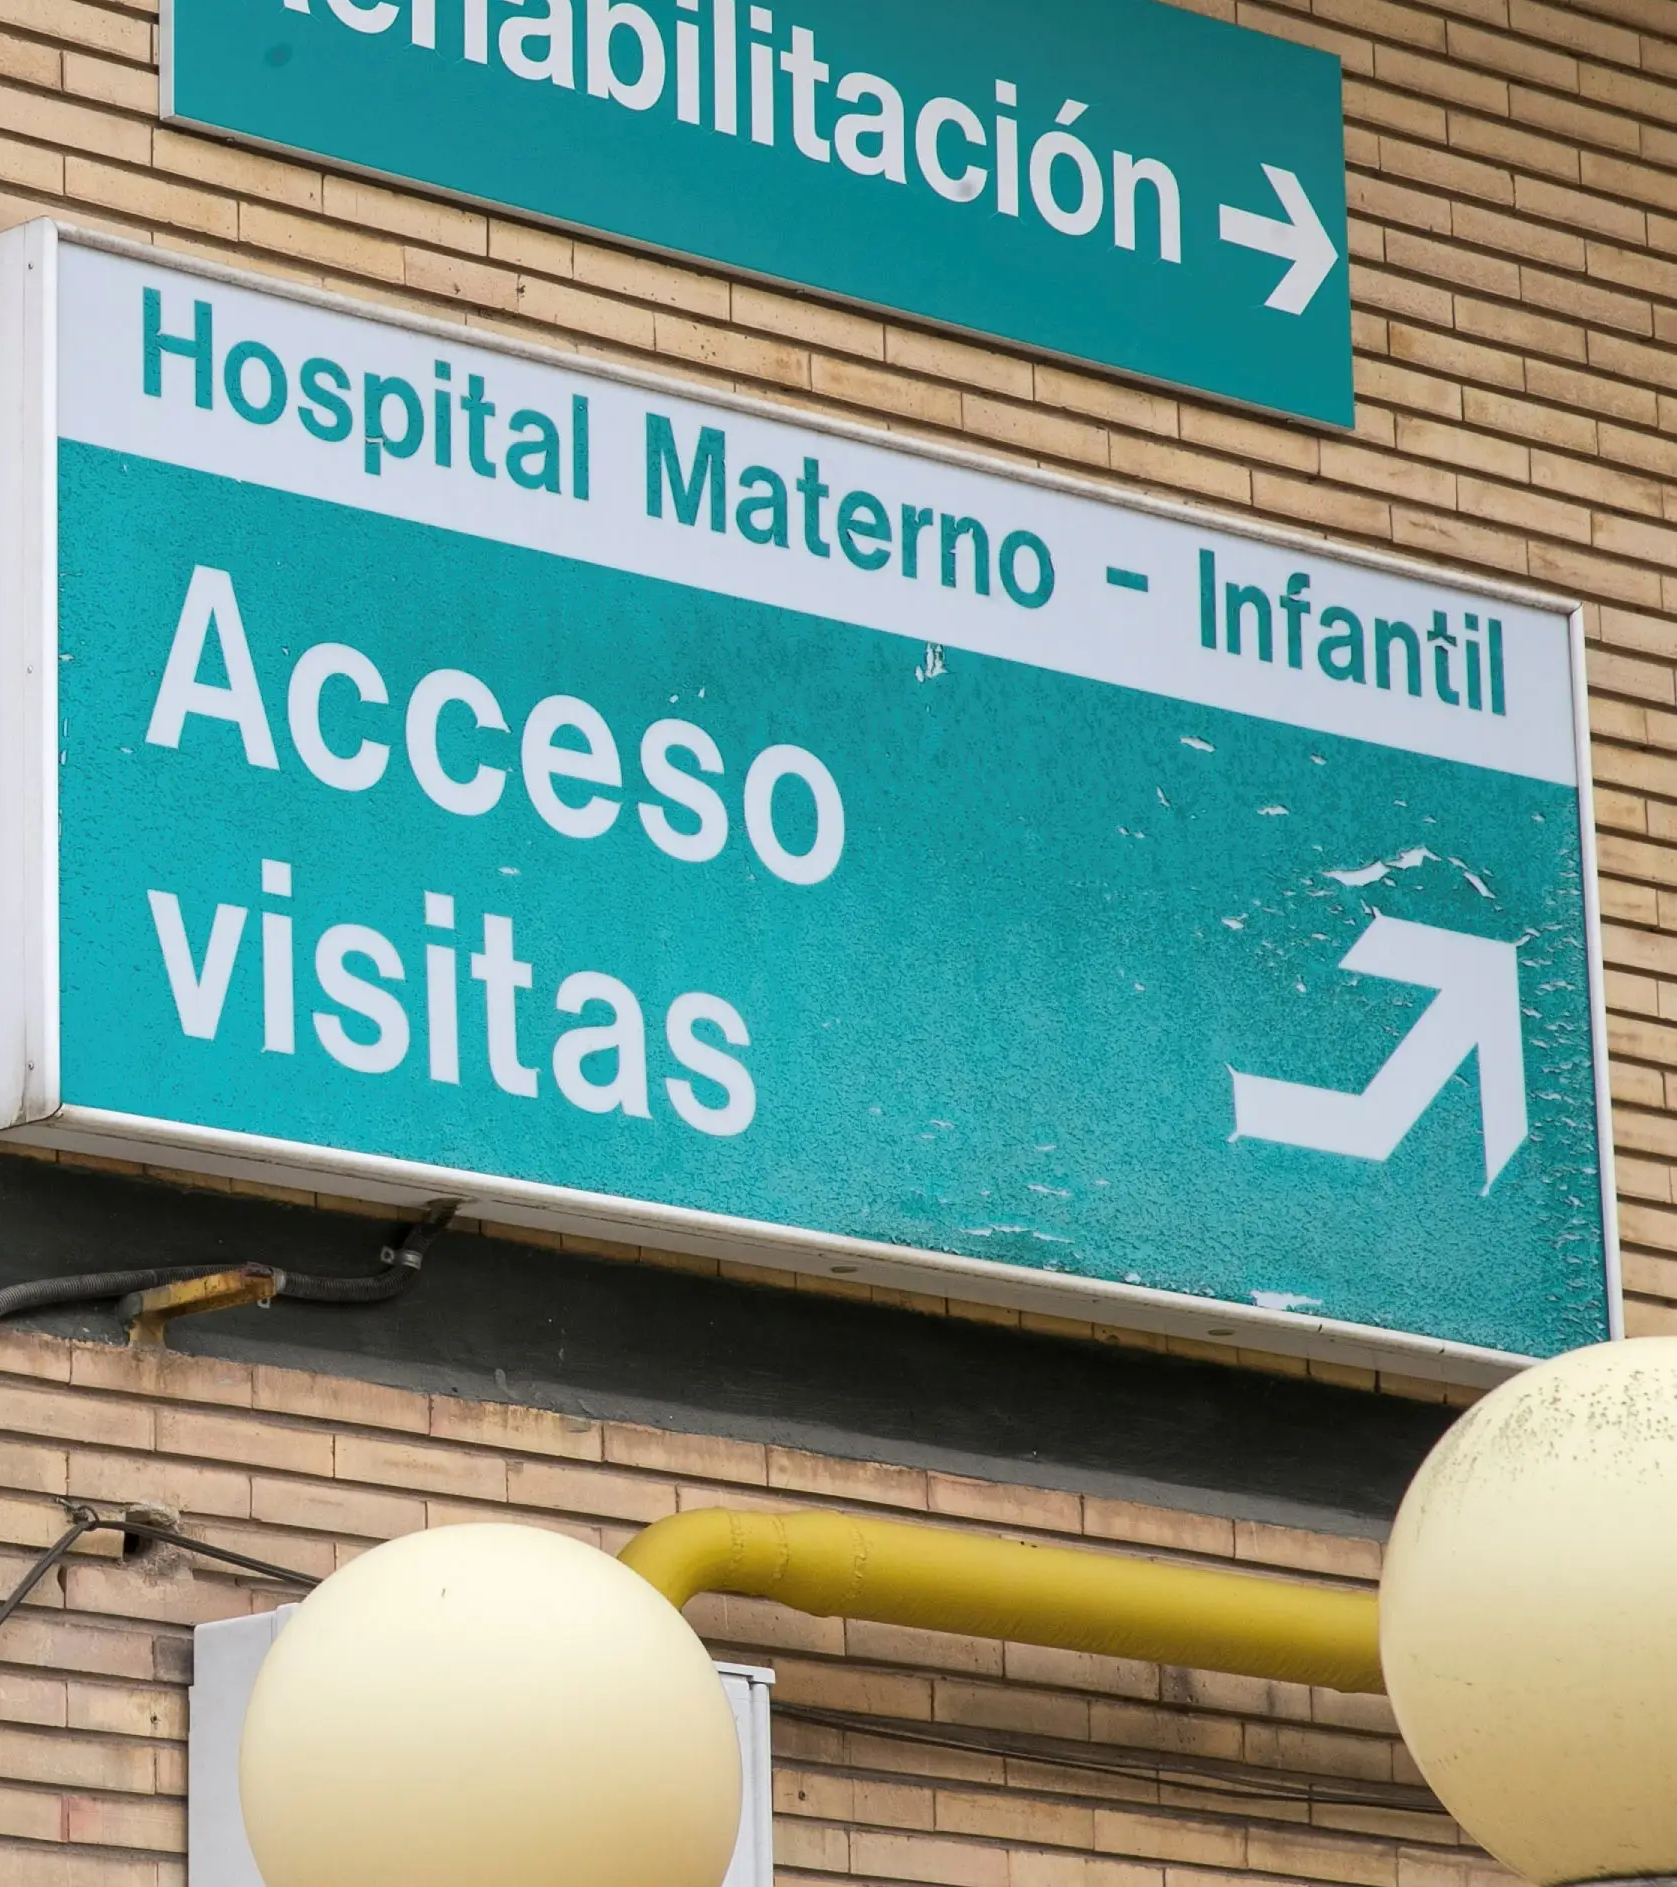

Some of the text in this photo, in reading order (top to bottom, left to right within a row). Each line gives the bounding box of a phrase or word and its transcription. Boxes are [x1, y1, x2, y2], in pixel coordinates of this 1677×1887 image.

[283, 0, 1181, 264] abilitación
[142, 286, 590, 502] Hospital
[646, 411, 1056, 610] Materno
[1198, 547, 1507, 717] Infantil
[145, 564, 845, 886] Acceso
[147, 858, 757, 1137] visitas
